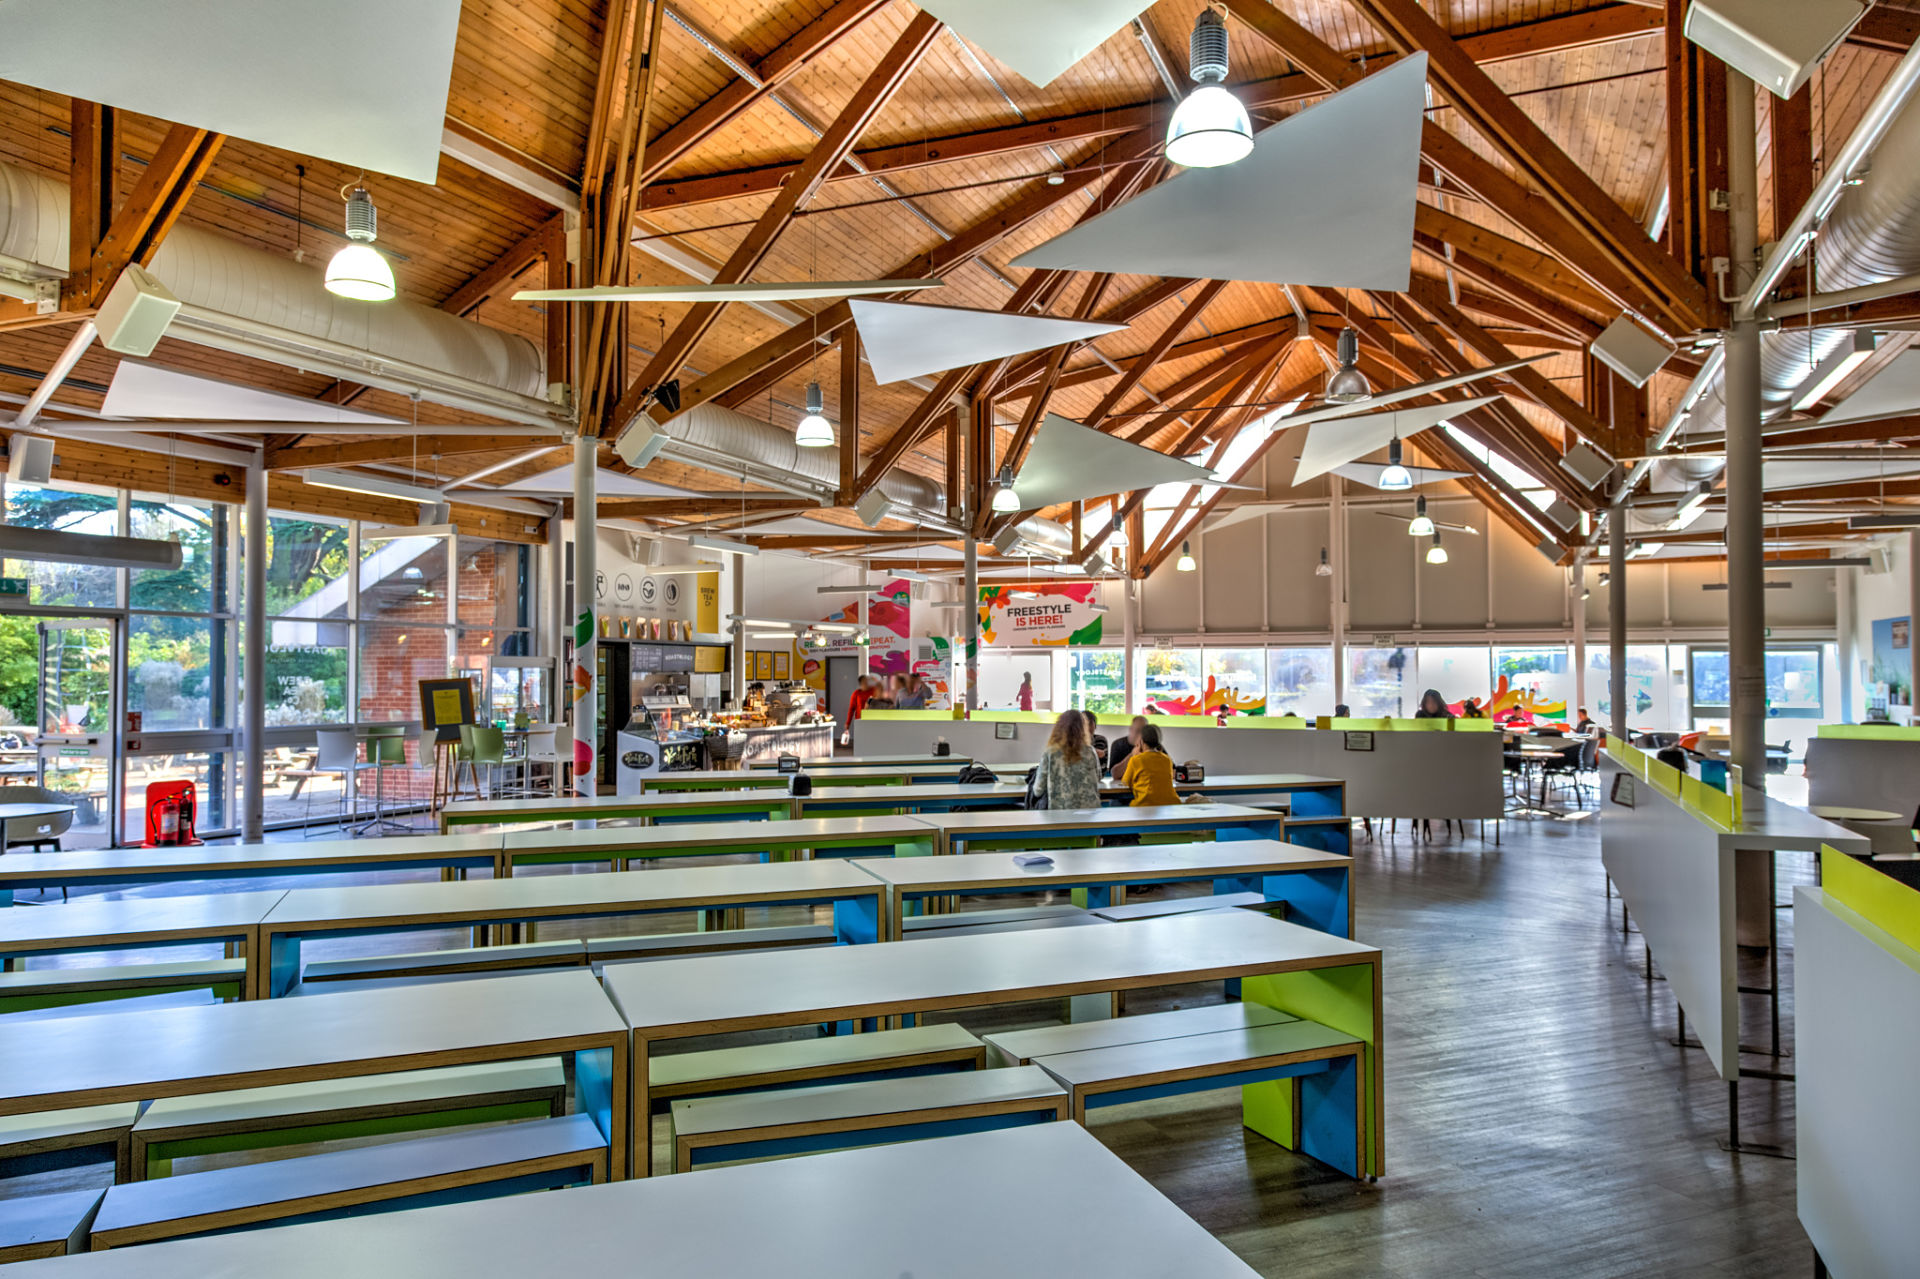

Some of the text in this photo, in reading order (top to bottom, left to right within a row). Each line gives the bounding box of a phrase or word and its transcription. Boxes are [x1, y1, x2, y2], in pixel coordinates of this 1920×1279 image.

[1007, 604, 1072, 617] FREESTYLE
[1016, 615, 1063, 626] IS HERE!
[868, 635, 896, 645] EPEAT.
